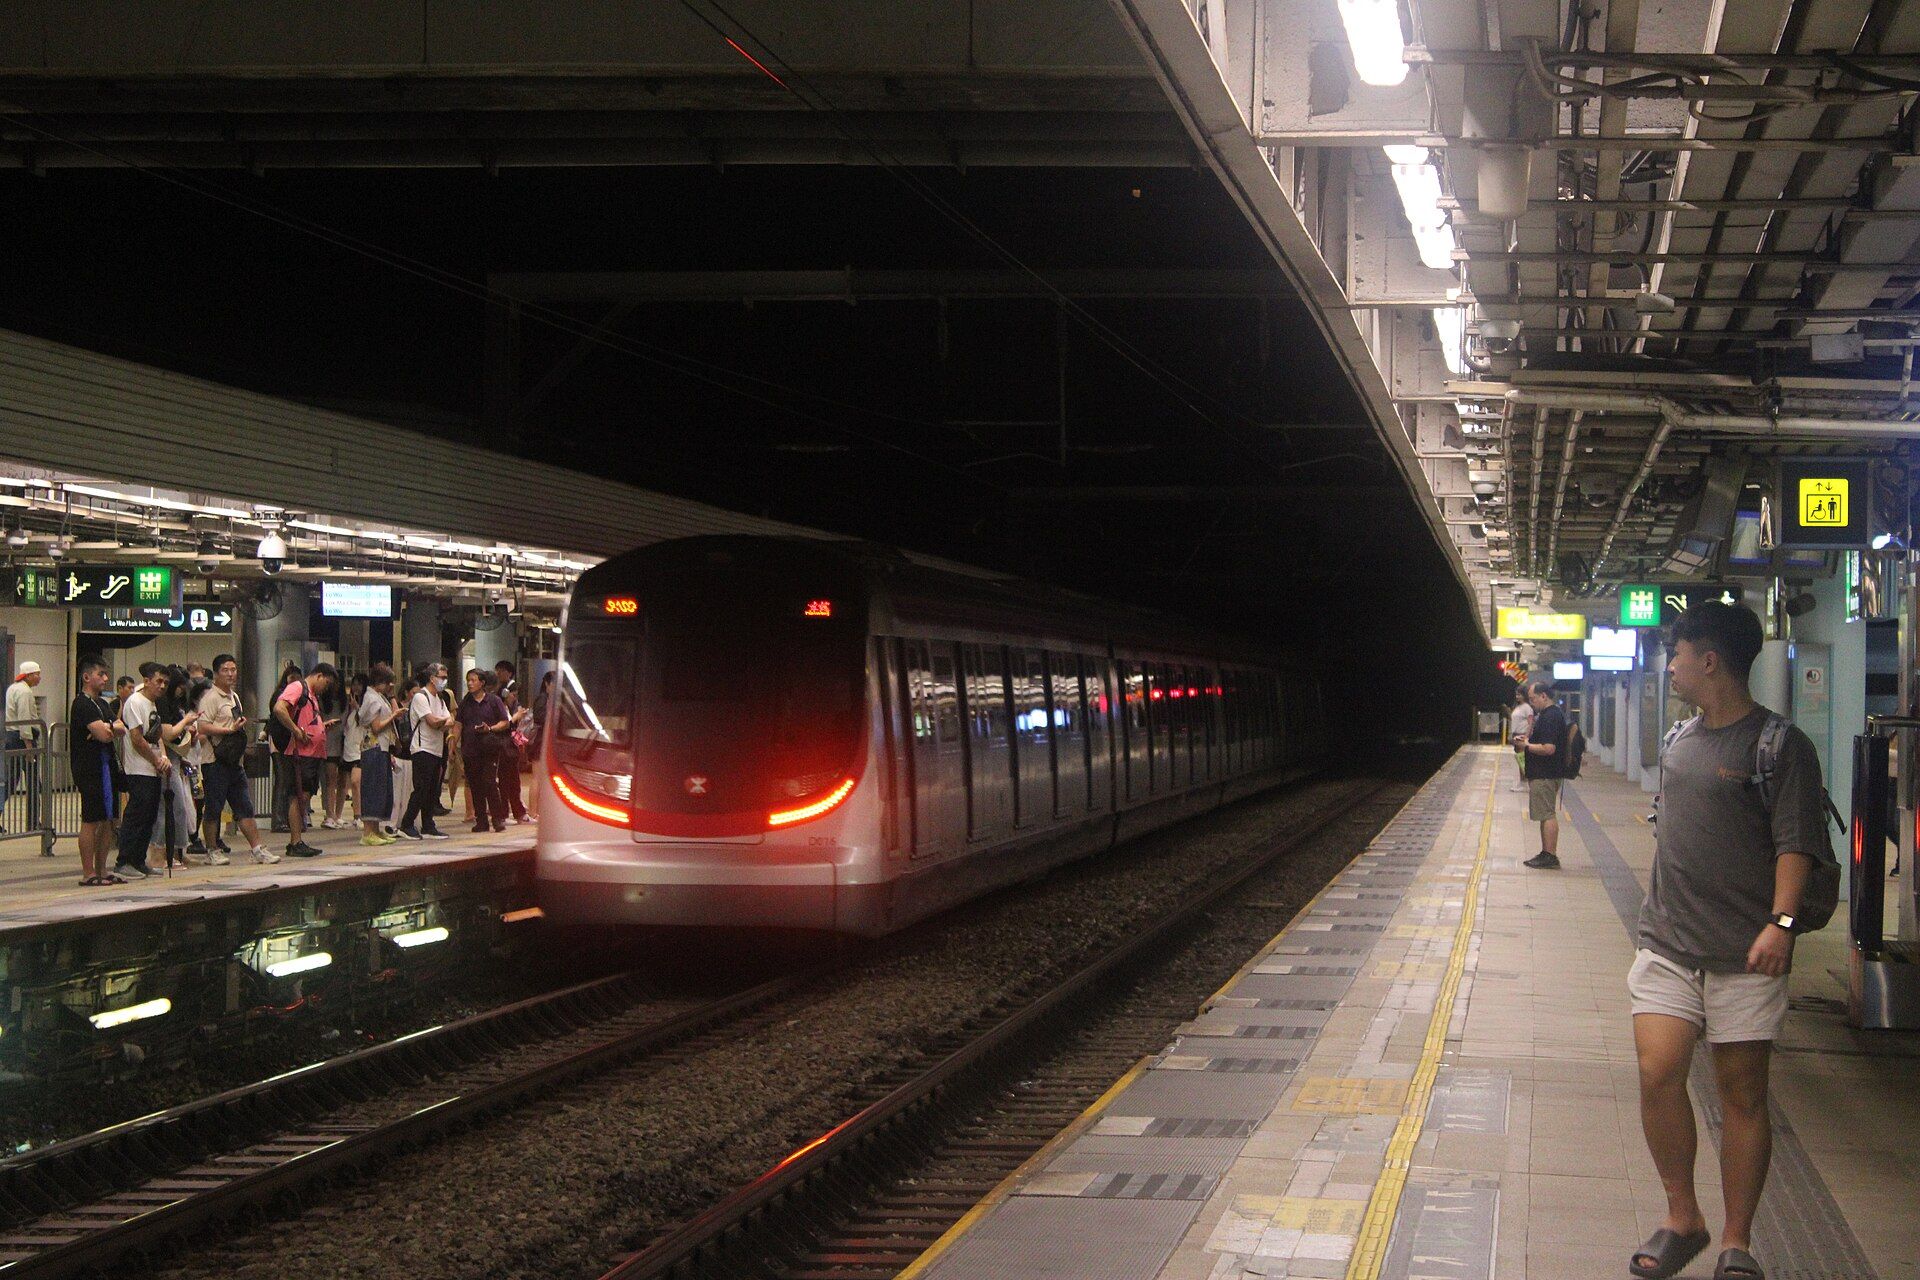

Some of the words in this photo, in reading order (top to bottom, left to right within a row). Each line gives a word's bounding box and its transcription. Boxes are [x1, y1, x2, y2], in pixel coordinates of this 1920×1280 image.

[140, 572, 162, 592] 出
[140, 592, 161, 600] EXIT
[1630, 590, 1654, 612] 出
[1630, 611, 1654, 620] EXIT
